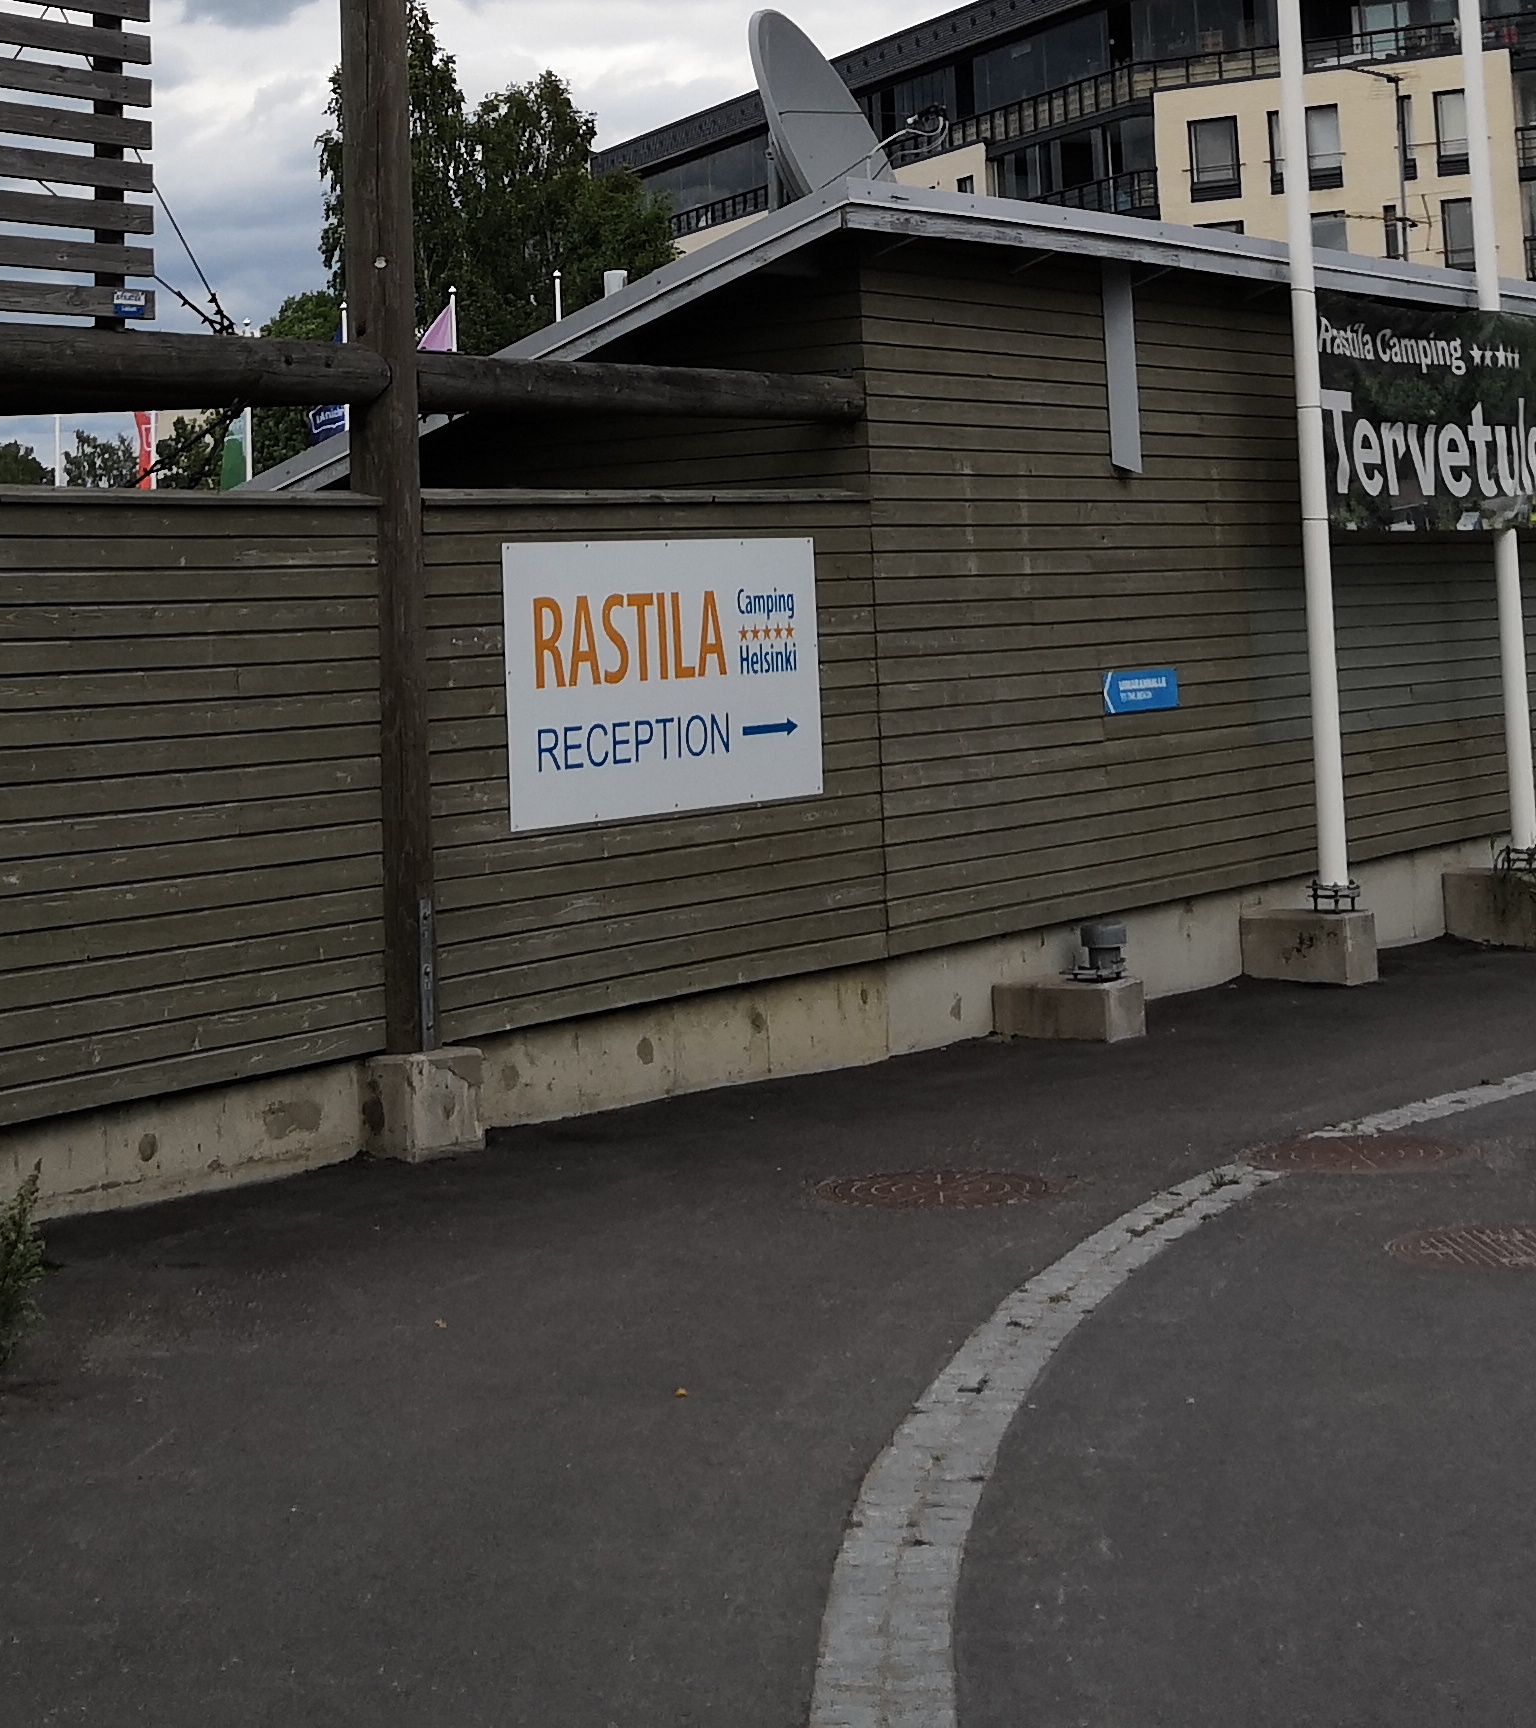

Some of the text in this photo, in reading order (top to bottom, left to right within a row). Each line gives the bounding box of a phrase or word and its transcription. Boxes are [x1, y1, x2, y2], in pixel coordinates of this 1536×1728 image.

[1318, 316, 1466, 377] Rastila Camping
[532, 587, 795, 689] RASTILA Camping
[739, 642, 799, 676] Helsinki
[536, 712, 731, 773] RECEPTION
